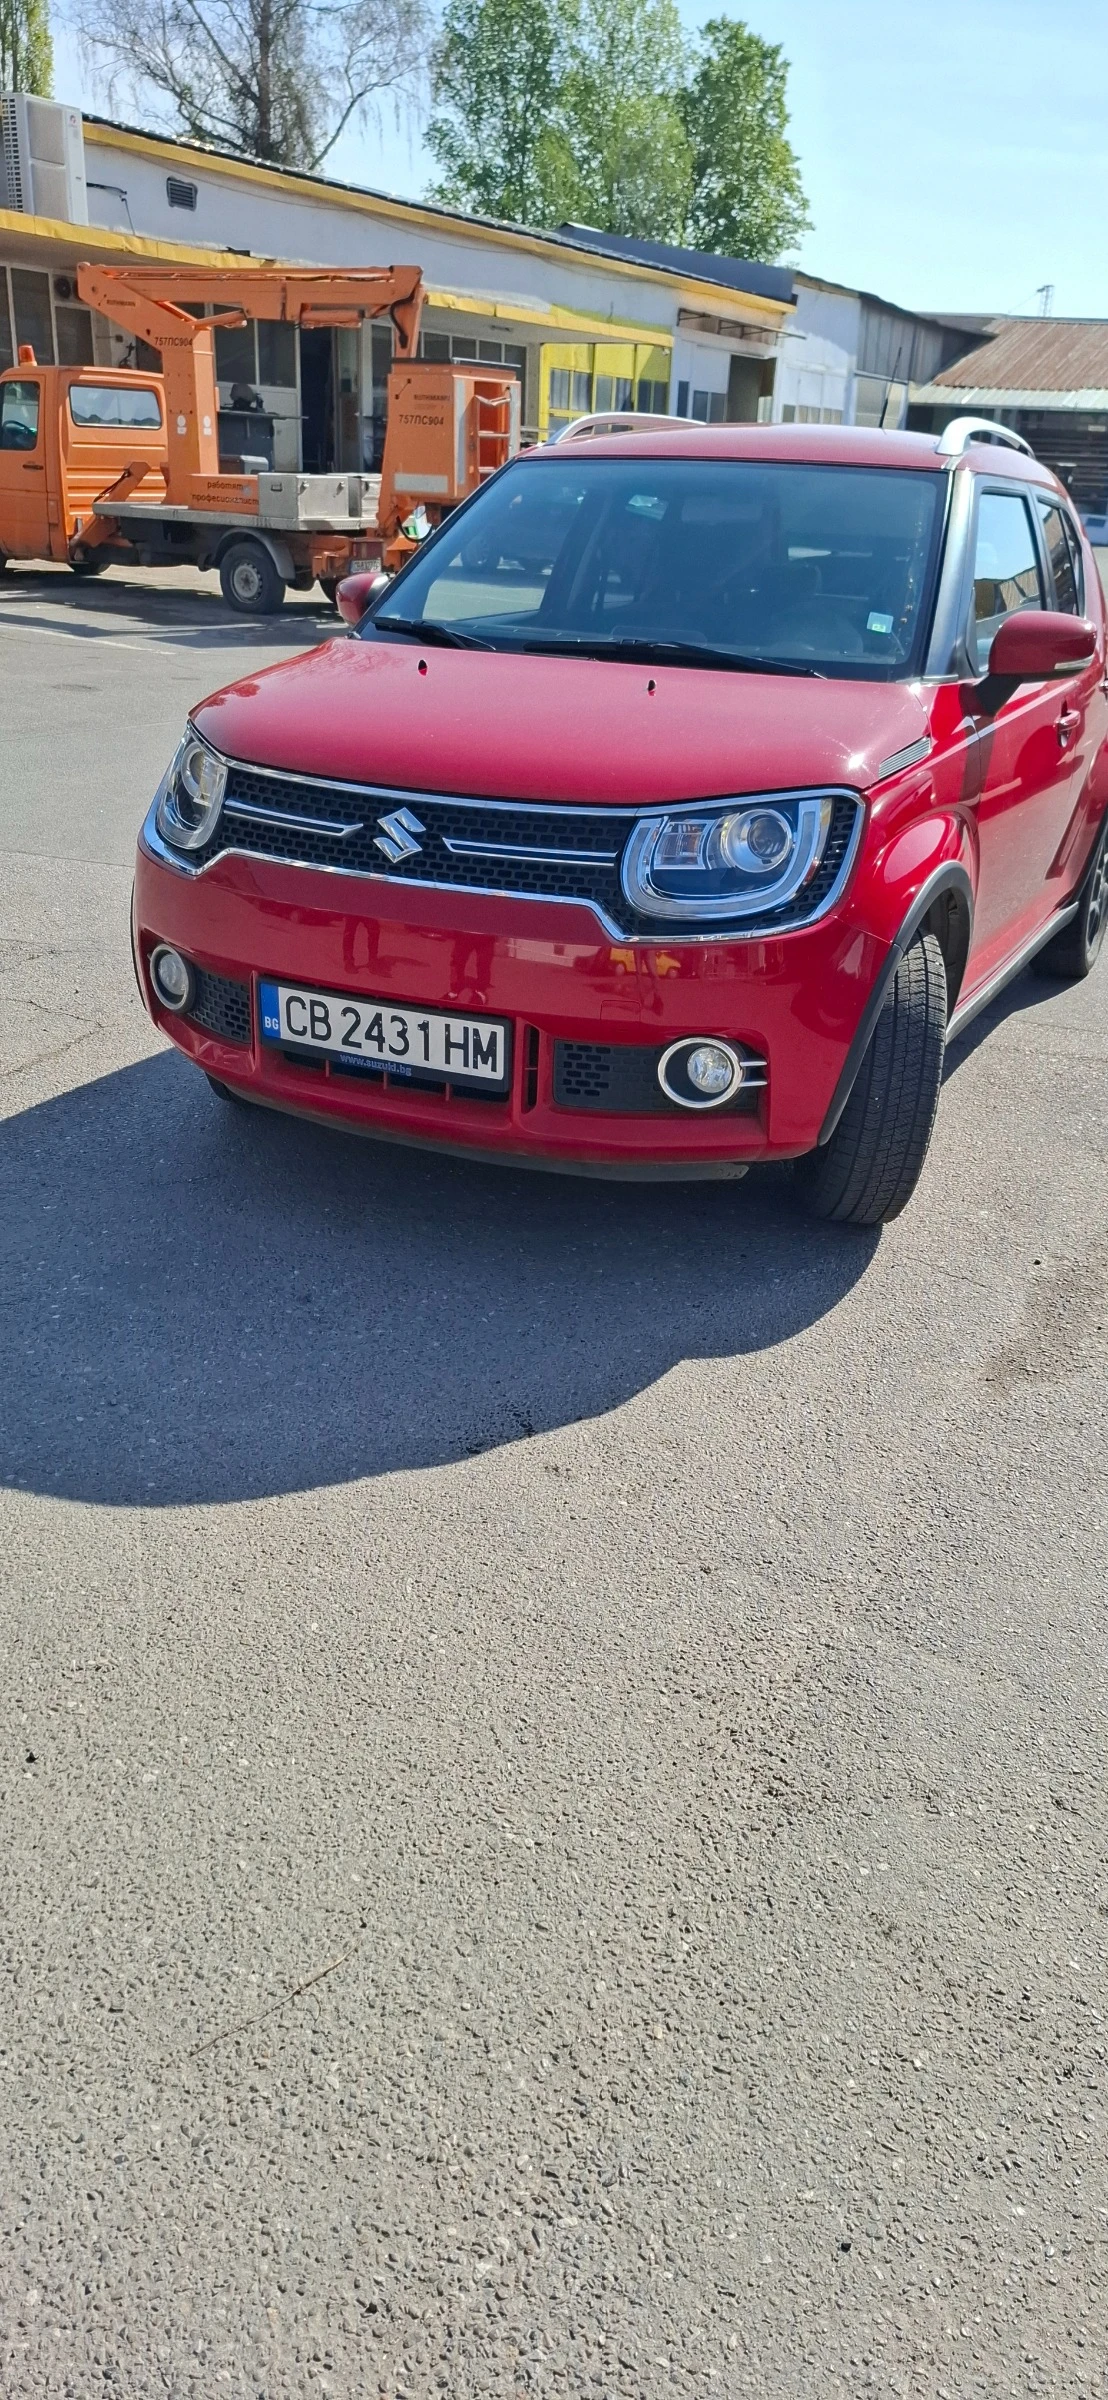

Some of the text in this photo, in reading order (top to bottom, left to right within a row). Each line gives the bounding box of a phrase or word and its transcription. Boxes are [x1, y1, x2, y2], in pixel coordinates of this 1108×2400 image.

[399, 414, 444, 425] 757ПС904
[265, 1016, 279, 1030] BG
[285, 995, 498, 1073] CB 2431 HM
[339, 1054, 412, 1077] www.suzuki.bg
